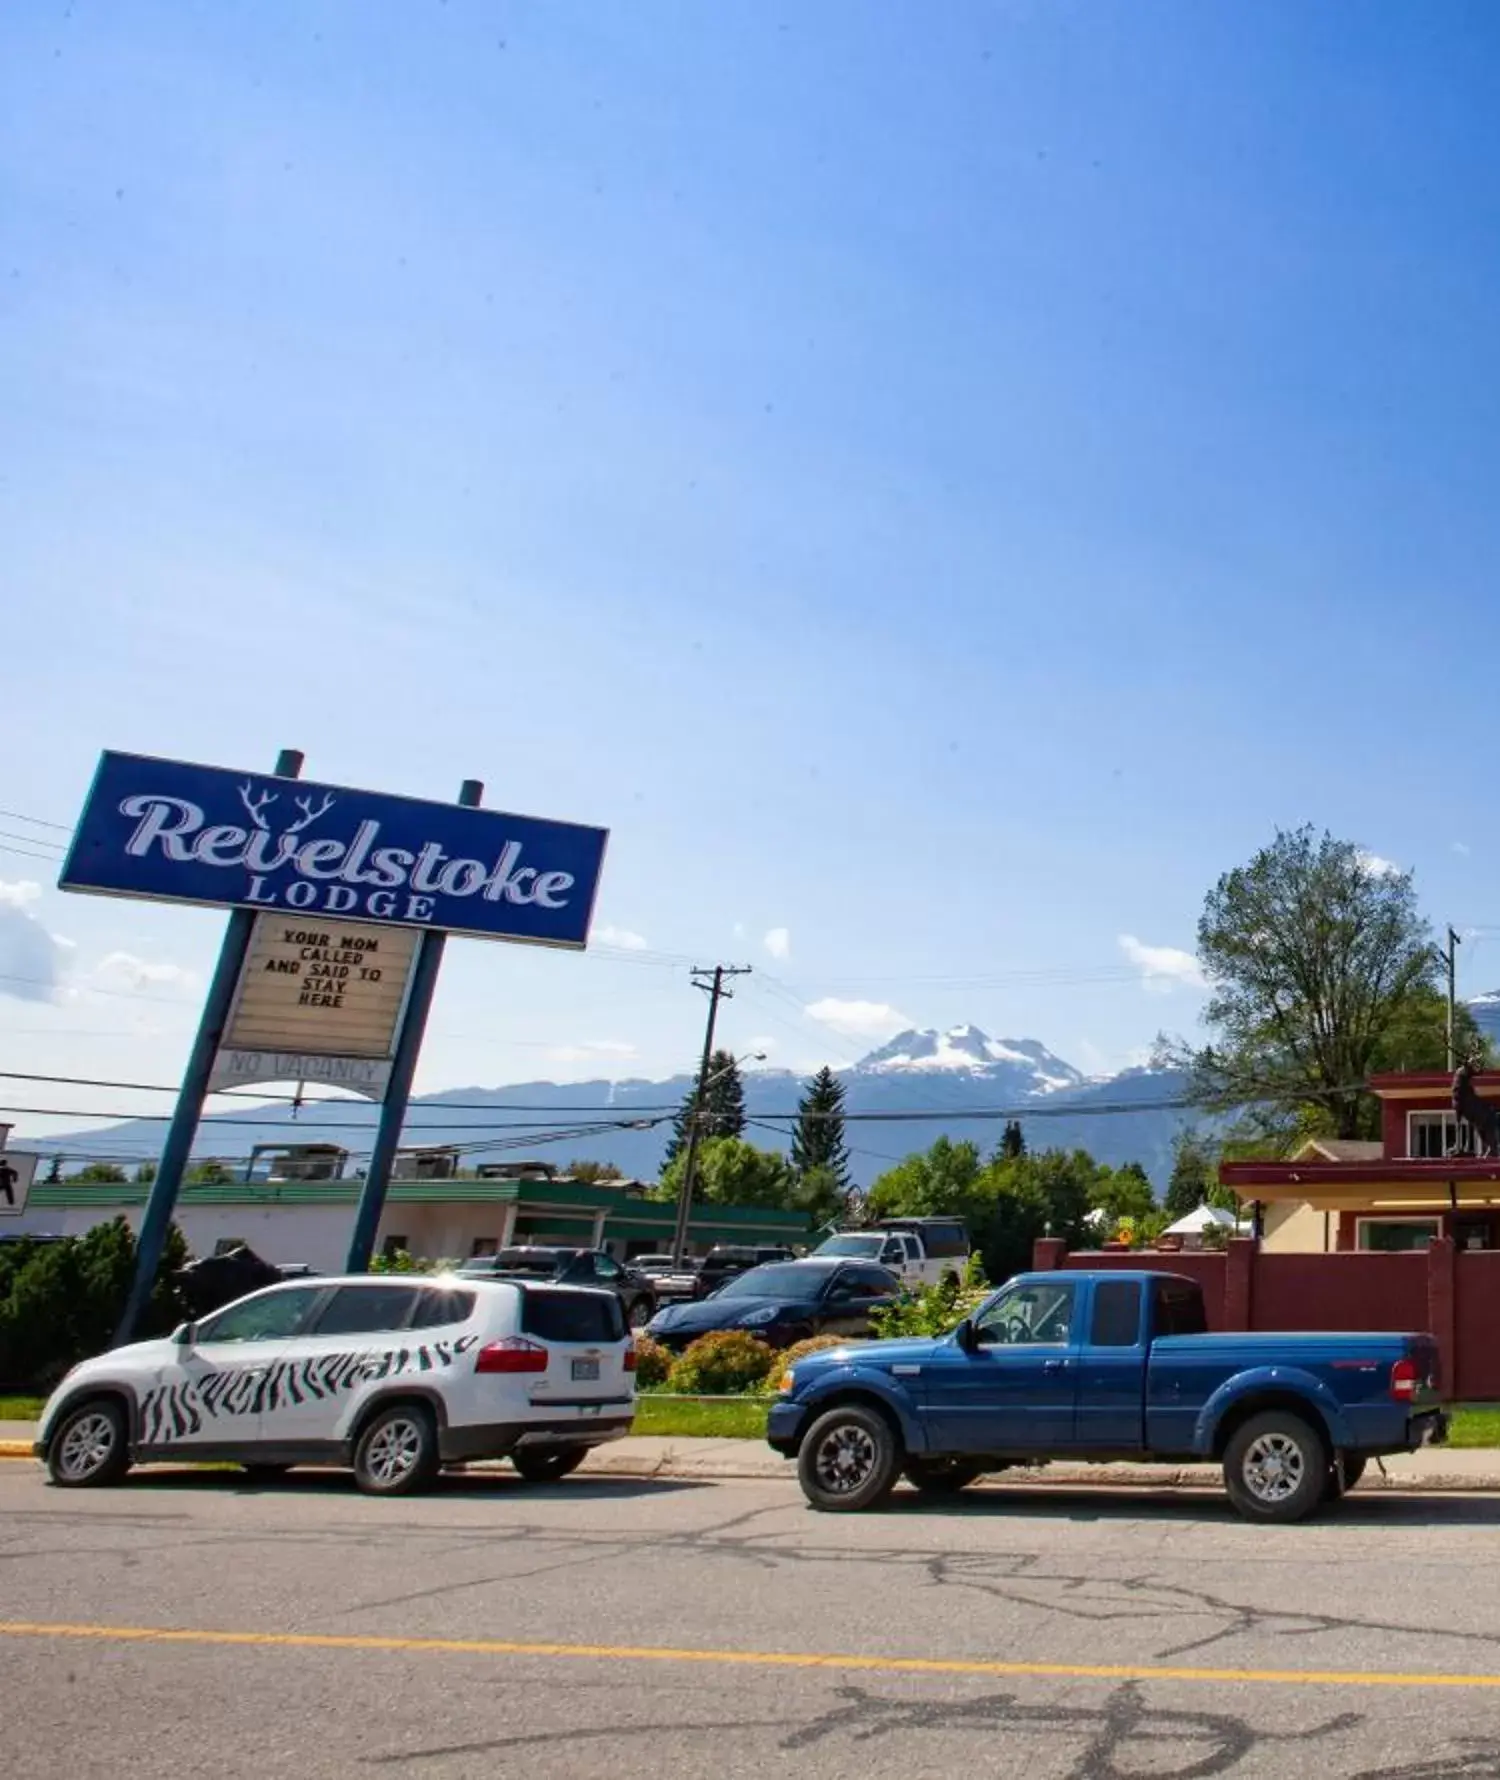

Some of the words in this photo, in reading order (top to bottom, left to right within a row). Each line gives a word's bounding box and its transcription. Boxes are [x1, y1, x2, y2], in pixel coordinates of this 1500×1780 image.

[120, 795, 575, 908] Revelstoke
[245, 875, 437, 922] LODGE
[285, 930, 330, 946] YOUR
[341, 936, 378, 951] MOM
[301, 948, 364, 965] CALLED
[266, 960, 300, 975] AND
[310, 964, 349, 978] SAID
[361, 968, 381, 981] TO
[303, 978, 346, 992] STAY
[299, 994, 344, 1008] HERE
[230, 1053, 262, 1075] NO
